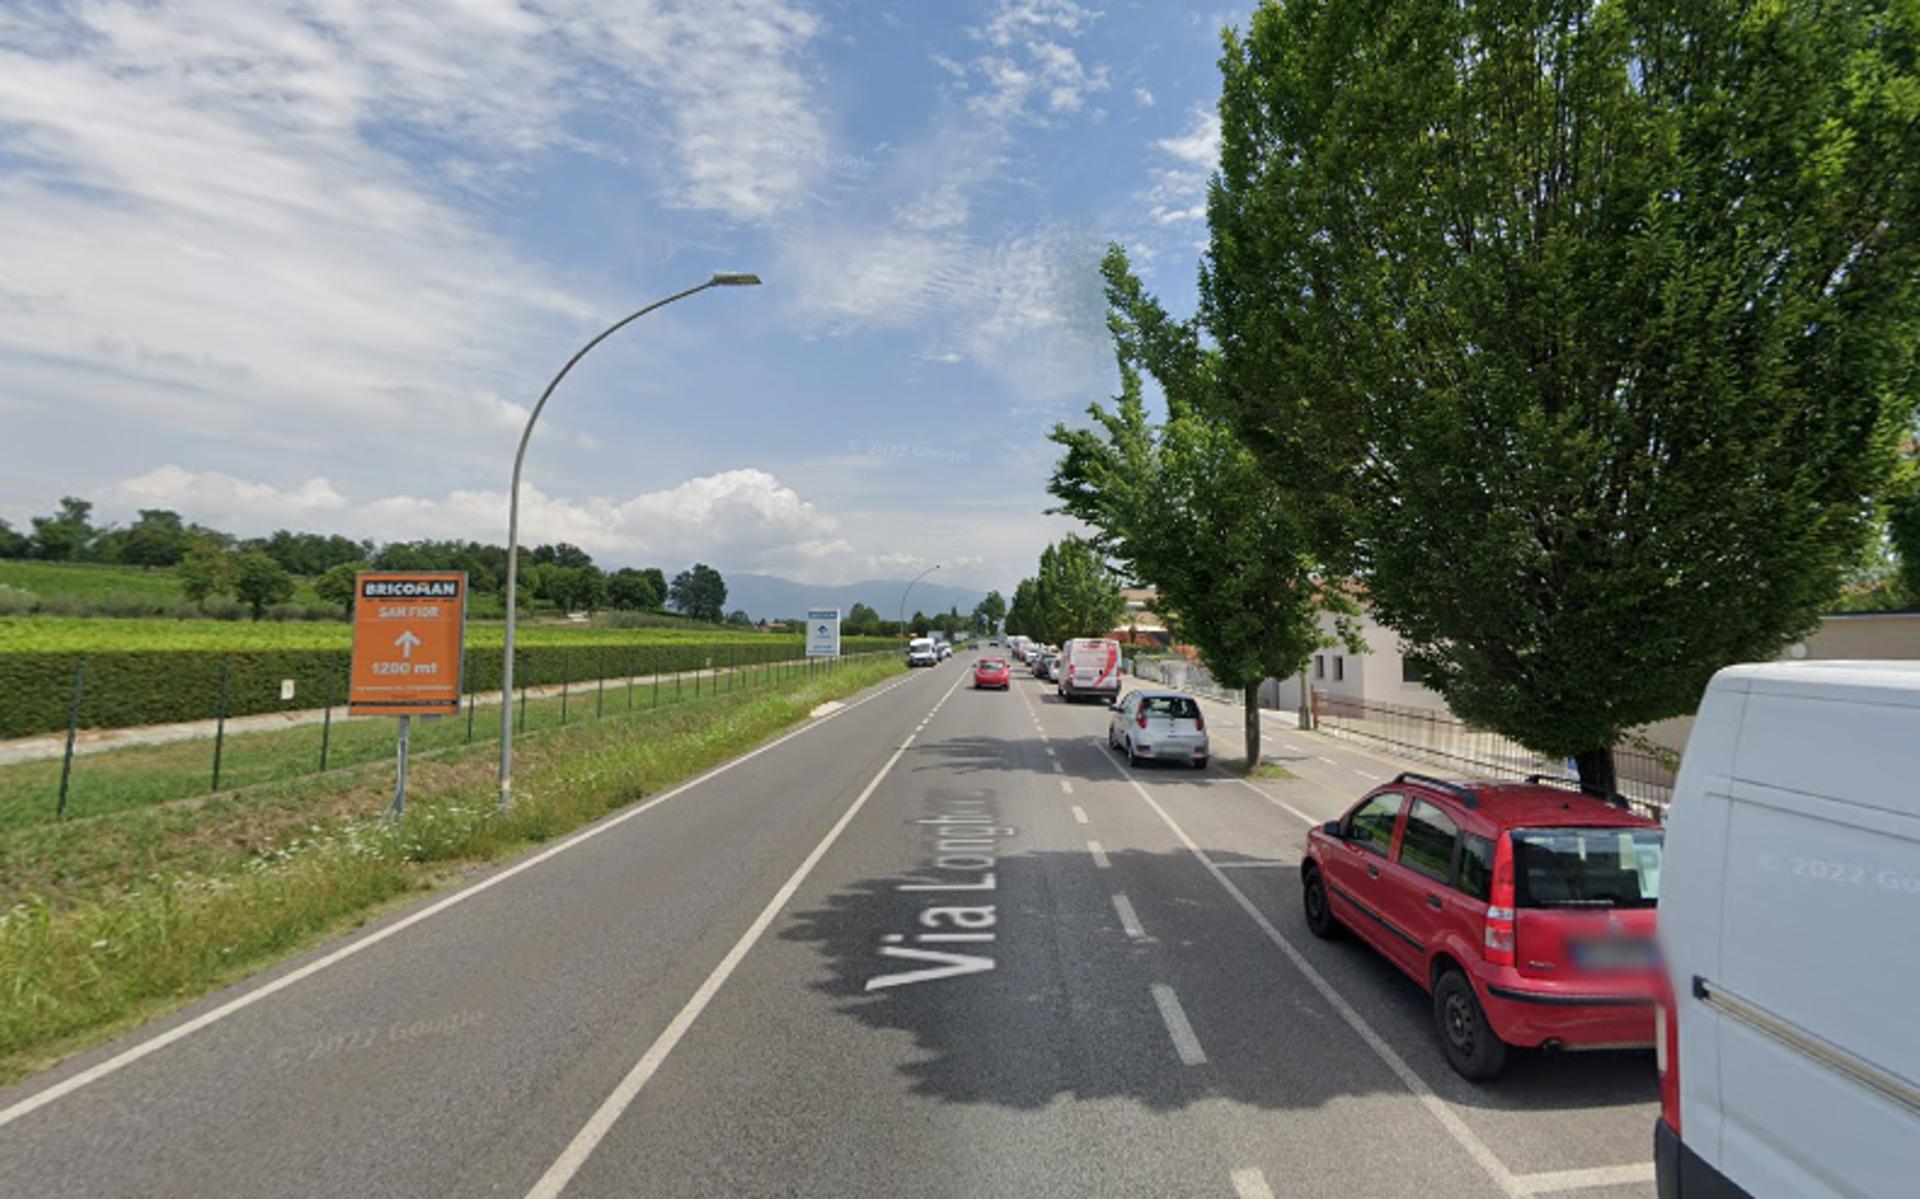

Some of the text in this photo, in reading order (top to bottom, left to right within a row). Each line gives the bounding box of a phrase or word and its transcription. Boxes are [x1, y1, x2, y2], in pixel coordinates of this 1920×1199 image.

[365, 582, 456, 596] BRICOMAN
[378, 606, 439, 618] SAN FIOR
[372, 662, 438, 675] 1200 mt
